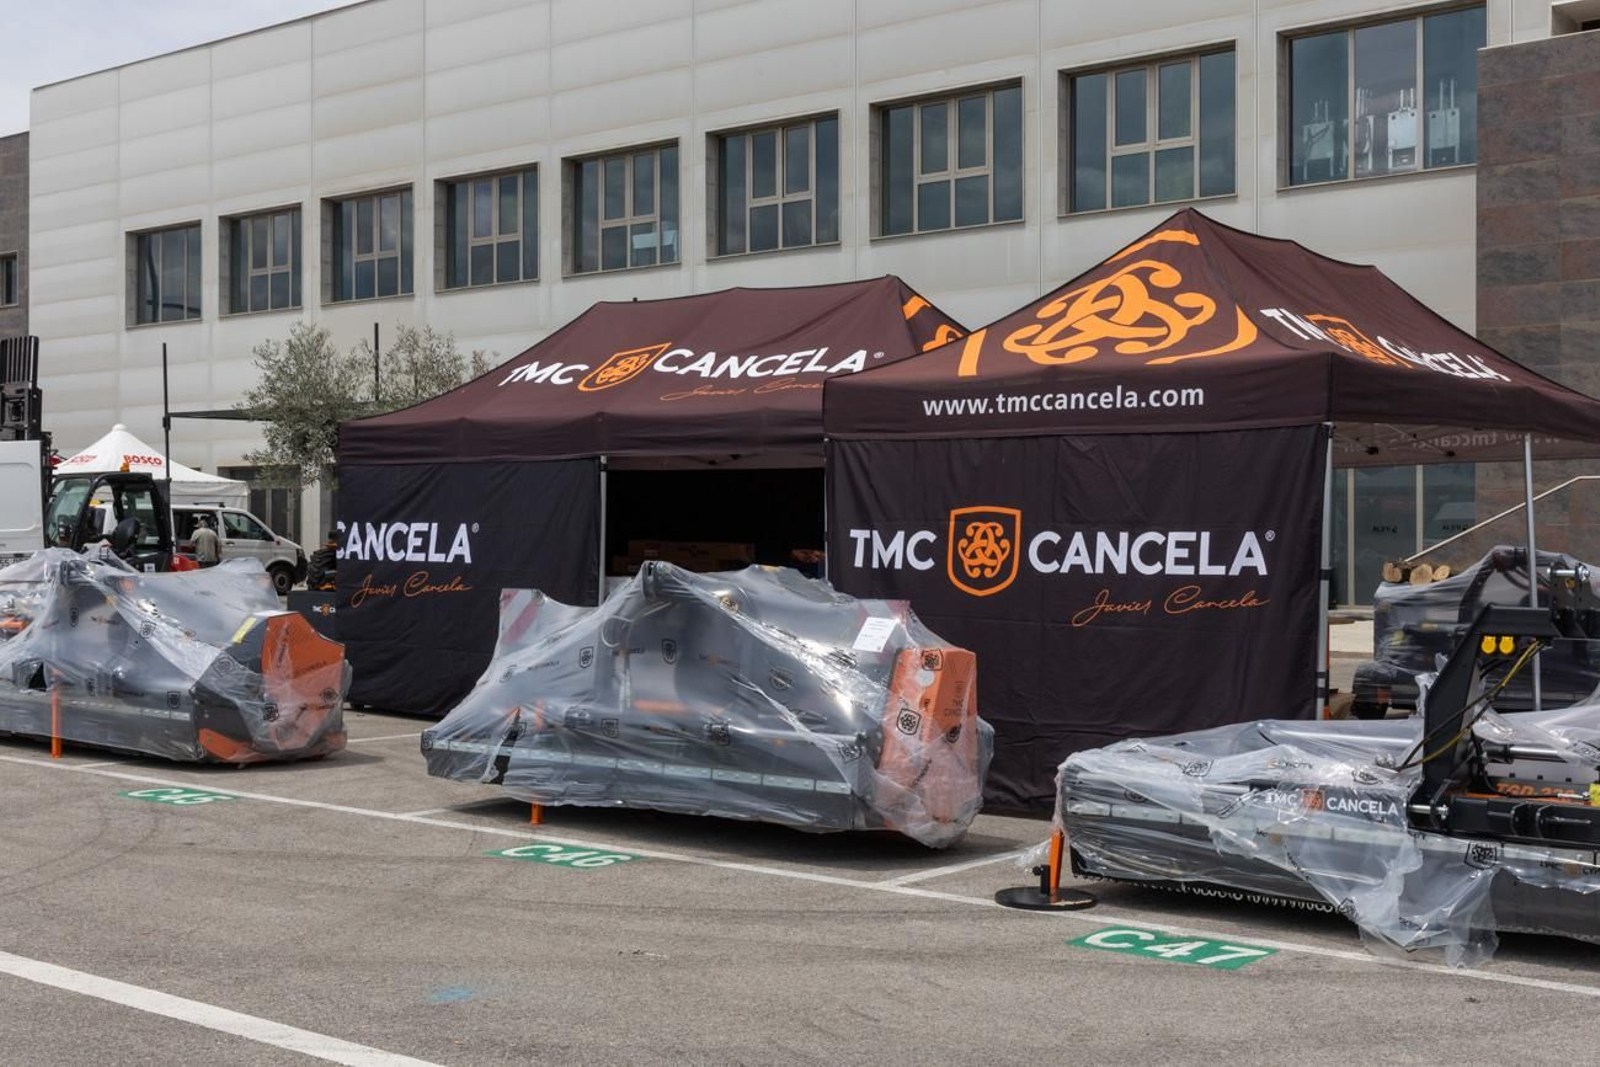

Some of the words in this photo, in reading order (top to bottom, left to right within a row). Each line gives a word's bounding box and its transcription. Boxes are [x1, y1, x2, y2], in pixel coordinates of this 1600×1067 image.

[923, 385, 1205, 417] www.tmccancela.com
[123, 455, 162, 466] BOSCO
[849, 529, 938, 571] TMC
[1327, 797, 1399, 815] CANCELA
[502, 844, 632, 867] C46
[1084, 930, 1269, 965] C47
